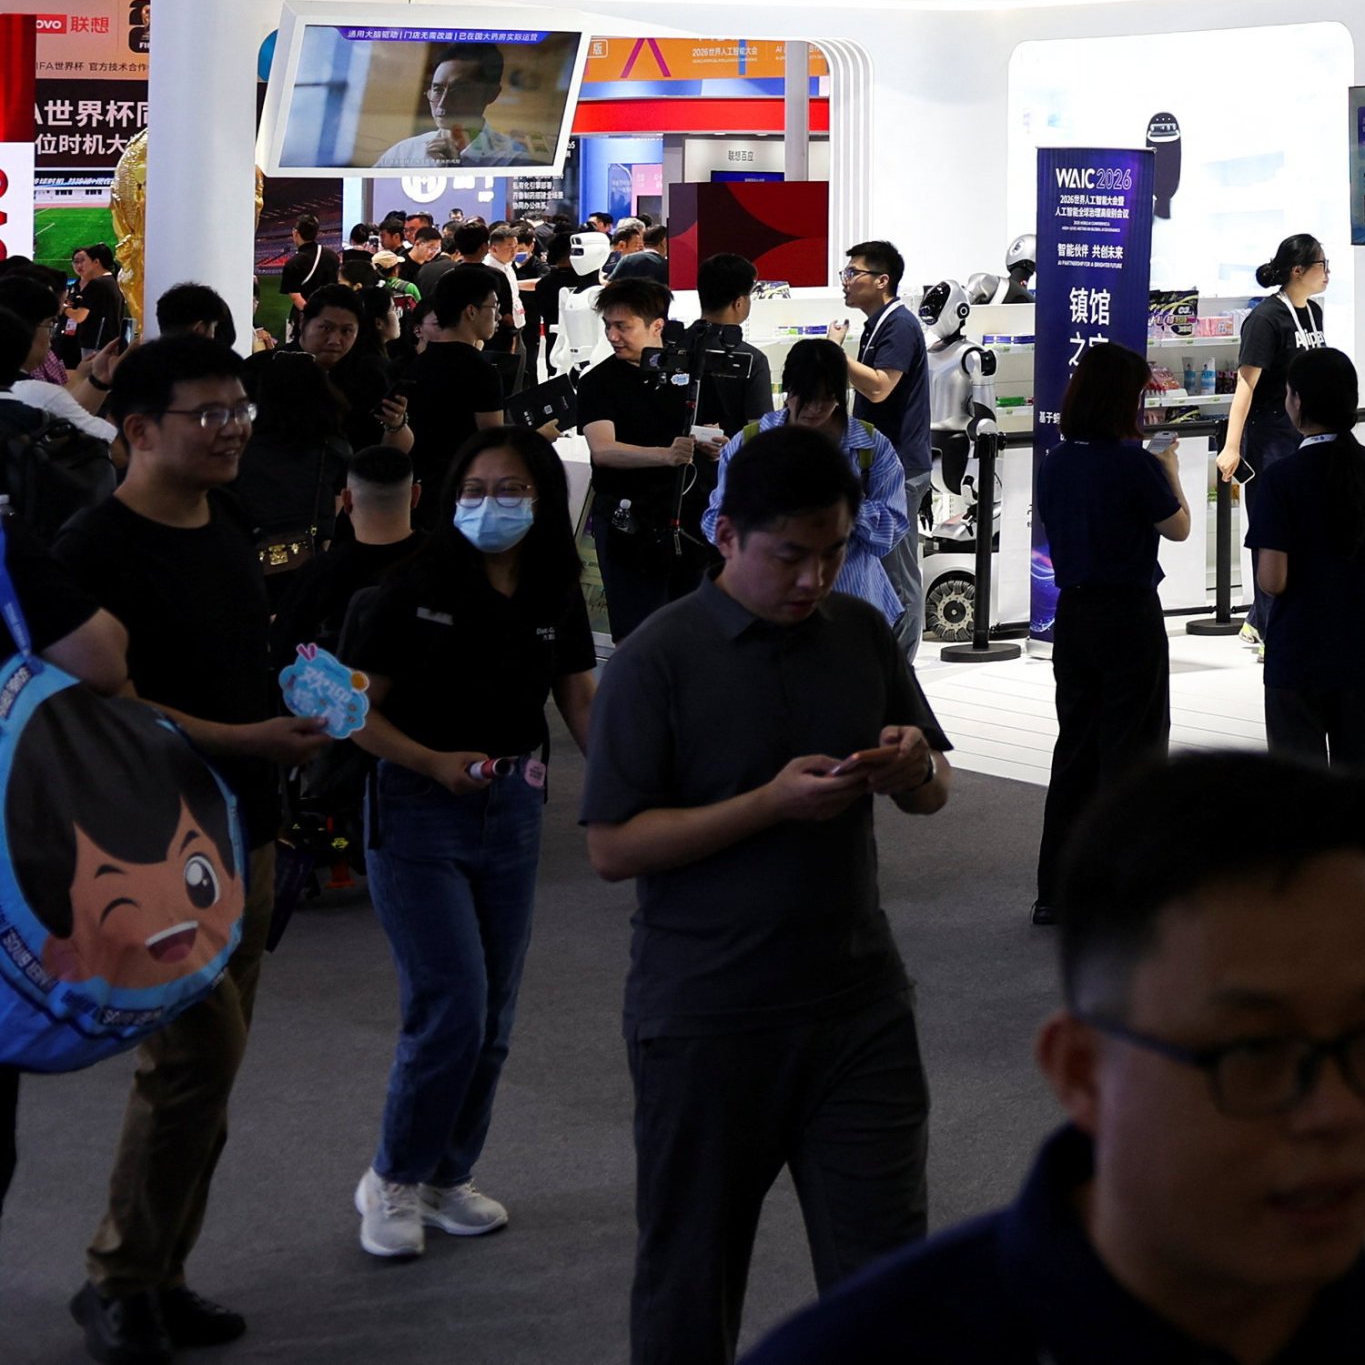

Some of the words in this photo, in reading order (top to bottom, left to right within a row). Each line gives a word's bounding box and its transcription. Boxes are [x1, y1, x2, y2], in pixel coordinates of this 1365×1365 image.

[71, 16, 109, 33] 联想
[89, 62, 149, 72] 官方技术合作
[1055, 168, 1096, 189] WAIC
[1096, 168, 1133, 190] 2026
[1069, 287, 1111, 325] 镇馆
